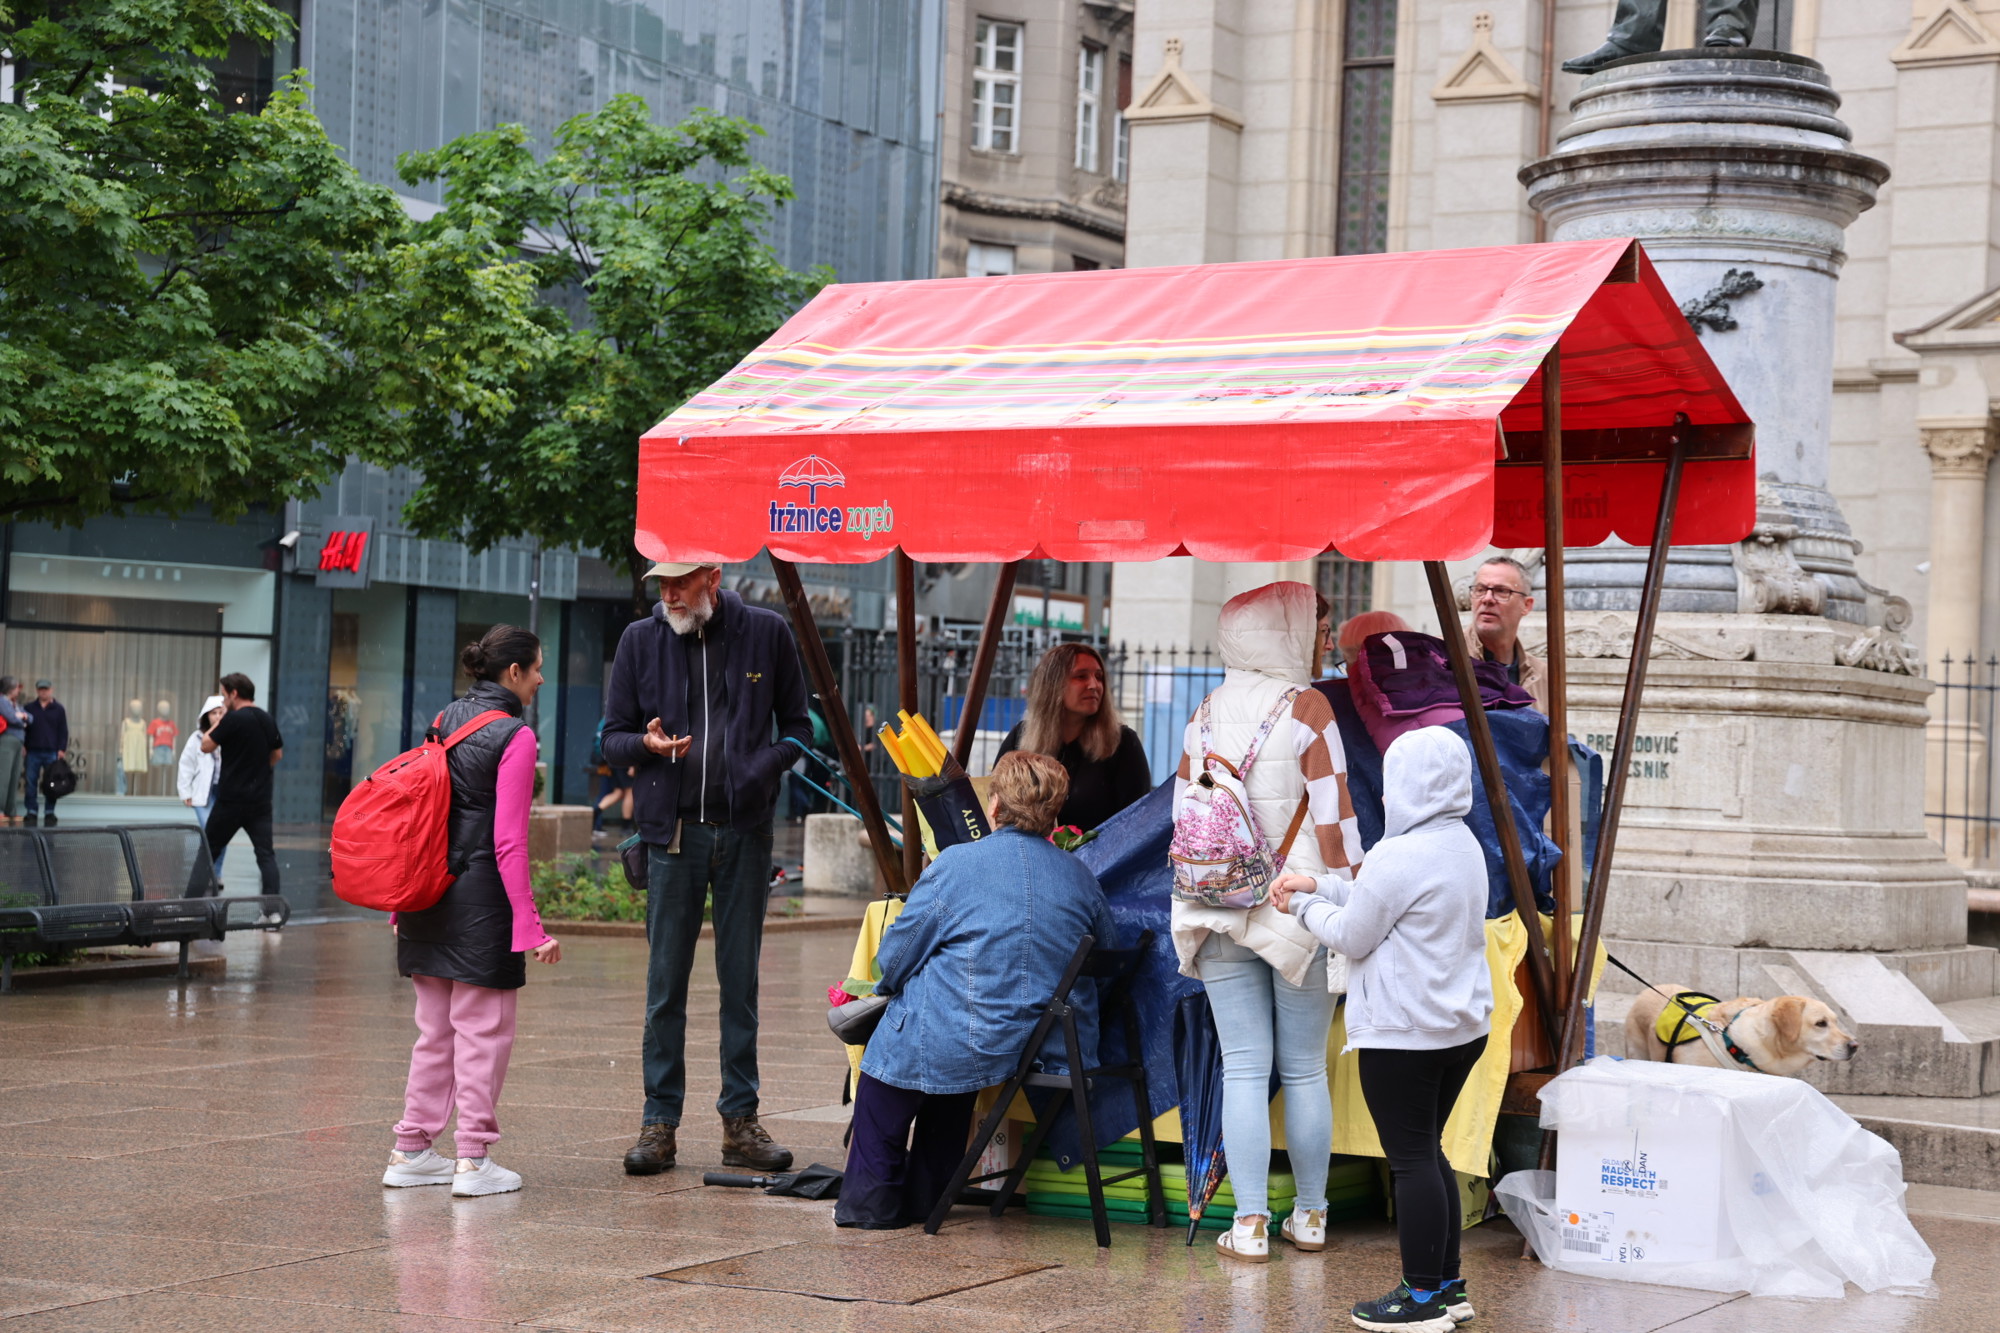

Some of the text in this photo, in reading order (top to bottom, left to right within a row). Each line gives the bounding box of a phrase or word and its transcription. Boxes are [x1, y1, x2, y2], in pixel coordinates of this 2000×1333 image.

[769, 500, 893, 540] tržnice zagreb
[319, 531, 368, 573] H&M
[1586, 731, 1679, 754] PREDOVIĆ
[1627, 760, 1669, 779] SNIK
[962, 809, 981, 842] CITY
[1601, 1174, 1655, 1190] RESPECT
